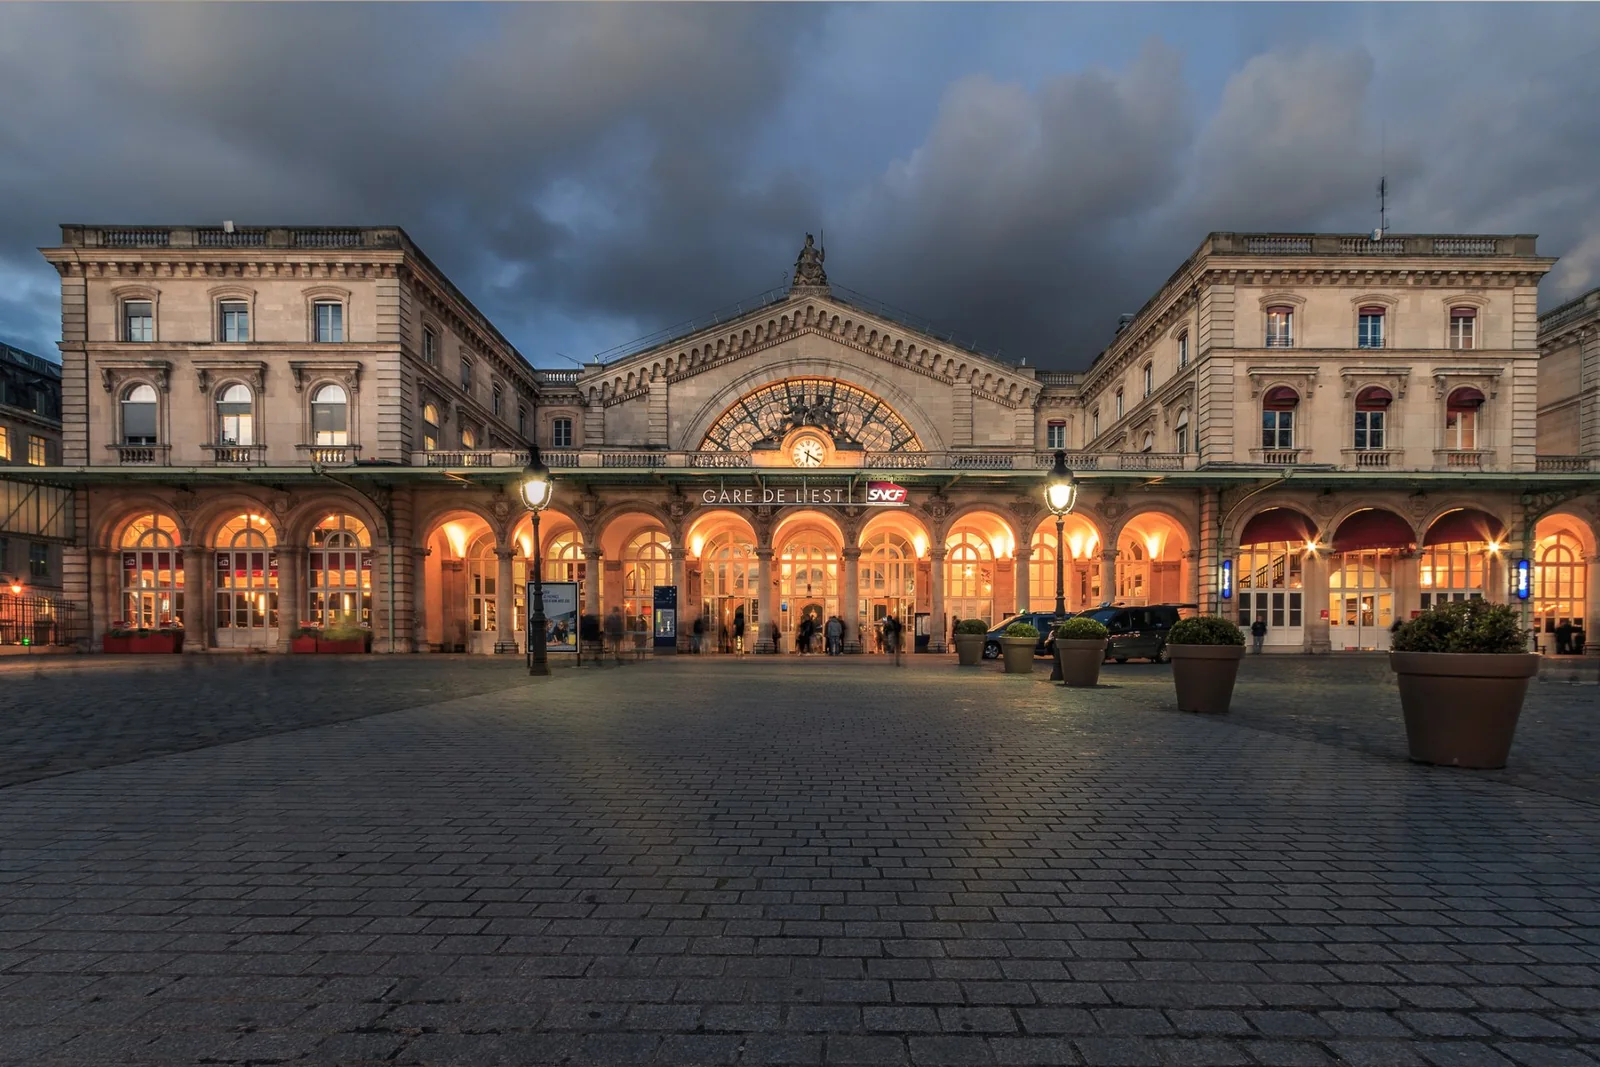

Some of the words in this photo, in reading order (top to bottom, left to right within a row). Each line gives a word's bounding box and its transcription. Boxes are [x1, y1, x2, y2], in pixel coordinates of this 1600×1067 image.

[702, 489, 753, 503] GARE
[763, 489, 785, 503] DE
[795, 489, 843, 503] L'EST
[868, 489, 905, 501] SNCF
